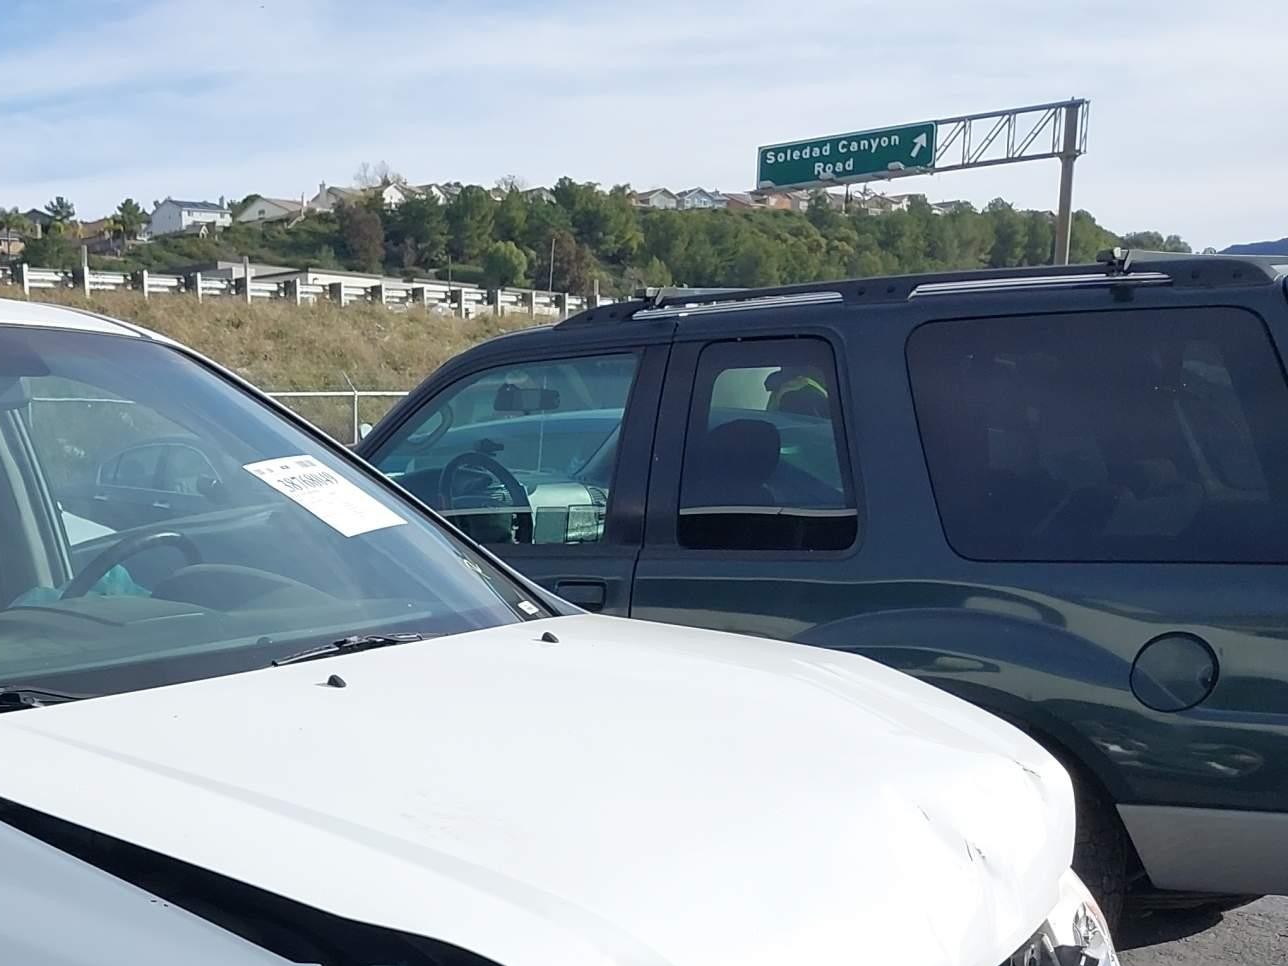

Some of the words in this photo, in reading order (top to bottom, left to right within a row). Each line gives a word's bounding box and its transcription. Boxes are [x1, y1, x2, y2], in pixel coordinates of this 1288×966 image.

[766, 143, 831, 164] Soledad
[838, 135, 900, 153] Canyon
[814, 158, 854, 176] Road
